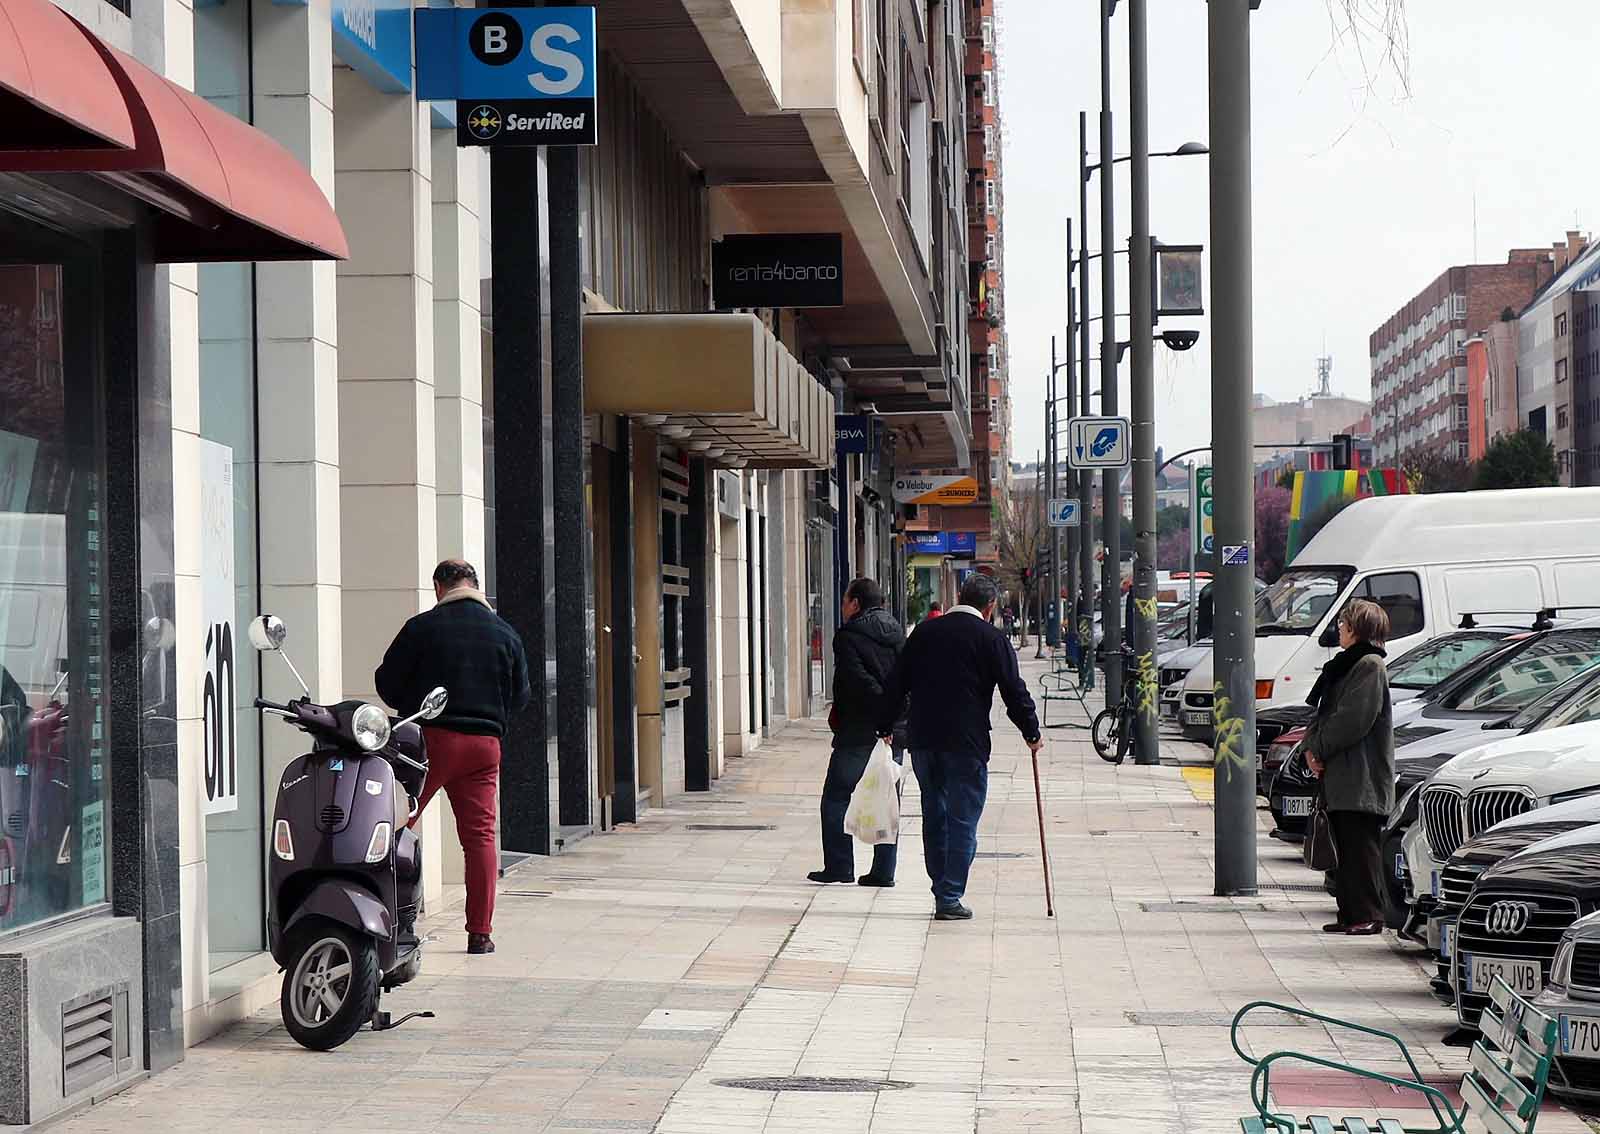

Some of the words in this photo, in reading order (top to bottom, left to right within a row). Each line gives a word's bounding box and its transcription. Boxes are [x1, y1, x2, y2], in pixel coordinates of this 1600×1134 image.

[506, 112, 585, 131] ServiRed
[729, 260, 838, 281] renta4banco
[1508, 965, 1535, 991] JVB
